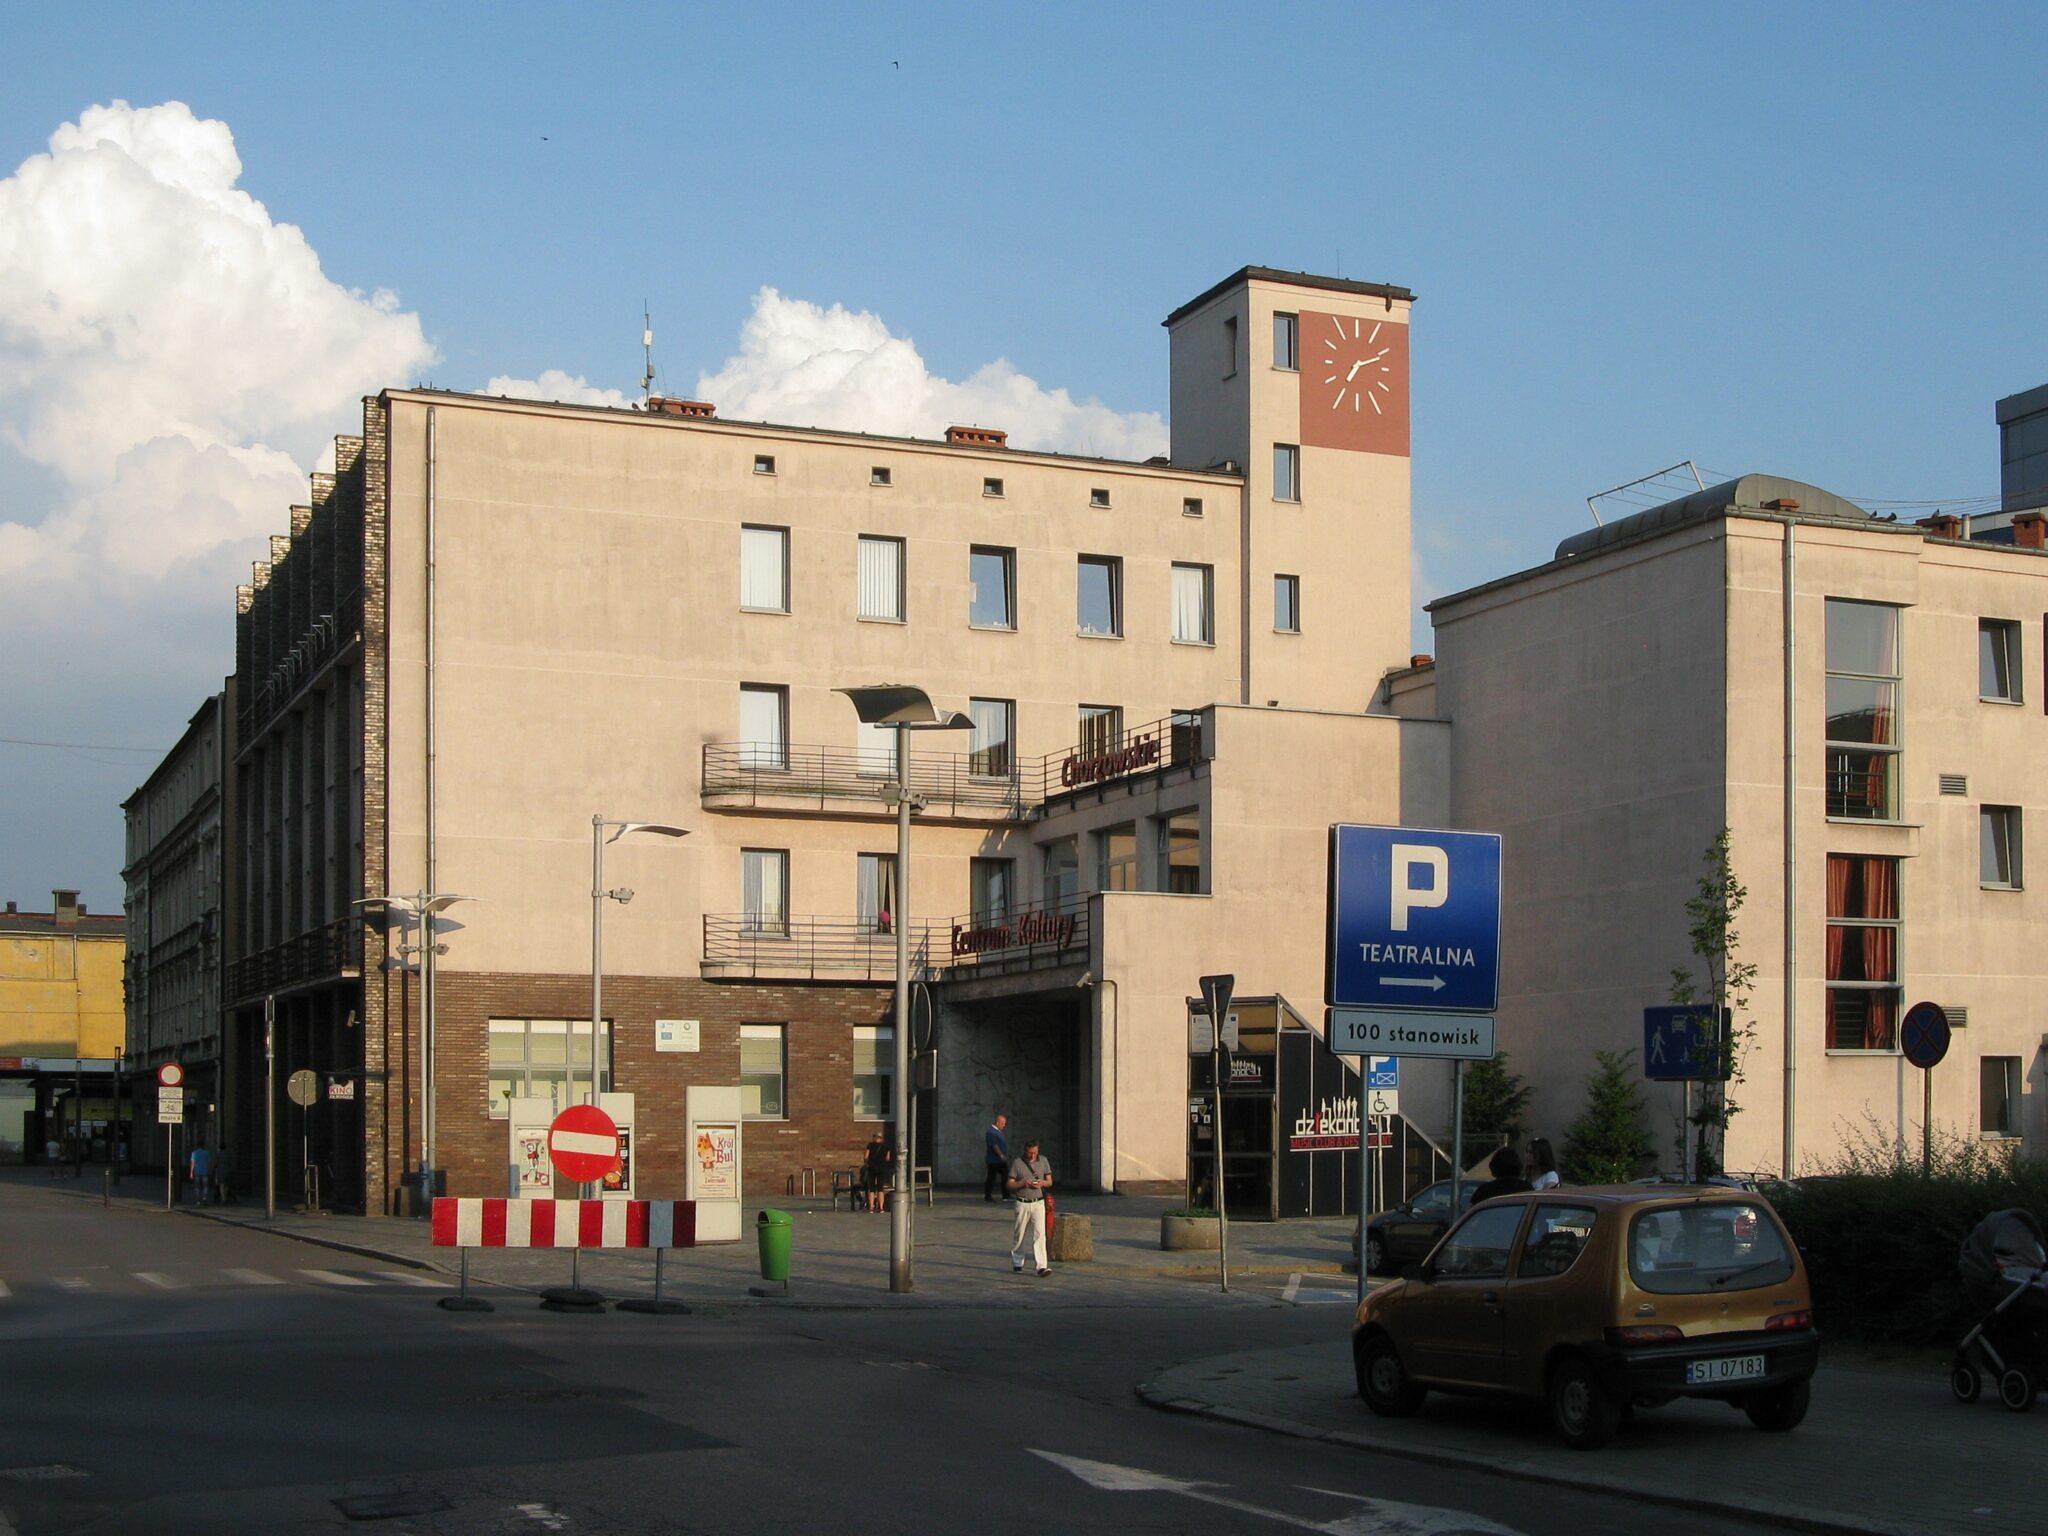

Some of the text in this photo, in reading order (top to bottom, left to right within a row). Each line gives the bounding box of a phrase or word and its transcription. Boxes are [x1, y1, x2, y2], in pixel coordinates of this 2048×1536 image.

[1062, 733, 1159, 787] Chorzowskie
[1390, 843, 1449, 932] P
[952, 910, 1075, 956] Centrum Kultury
[1360, 943, 1476, 967] TEATRALNA
[1348, 1023, 1480, 1045] 100 stanowisk
[717, 1137, 734, 1149] Król
[1290, 1137, 1313, 1148] MUSIC
[1315, 1136, 1336, 1147] CLUB
[1695, 1357, 1763, 1379] SI 07183
